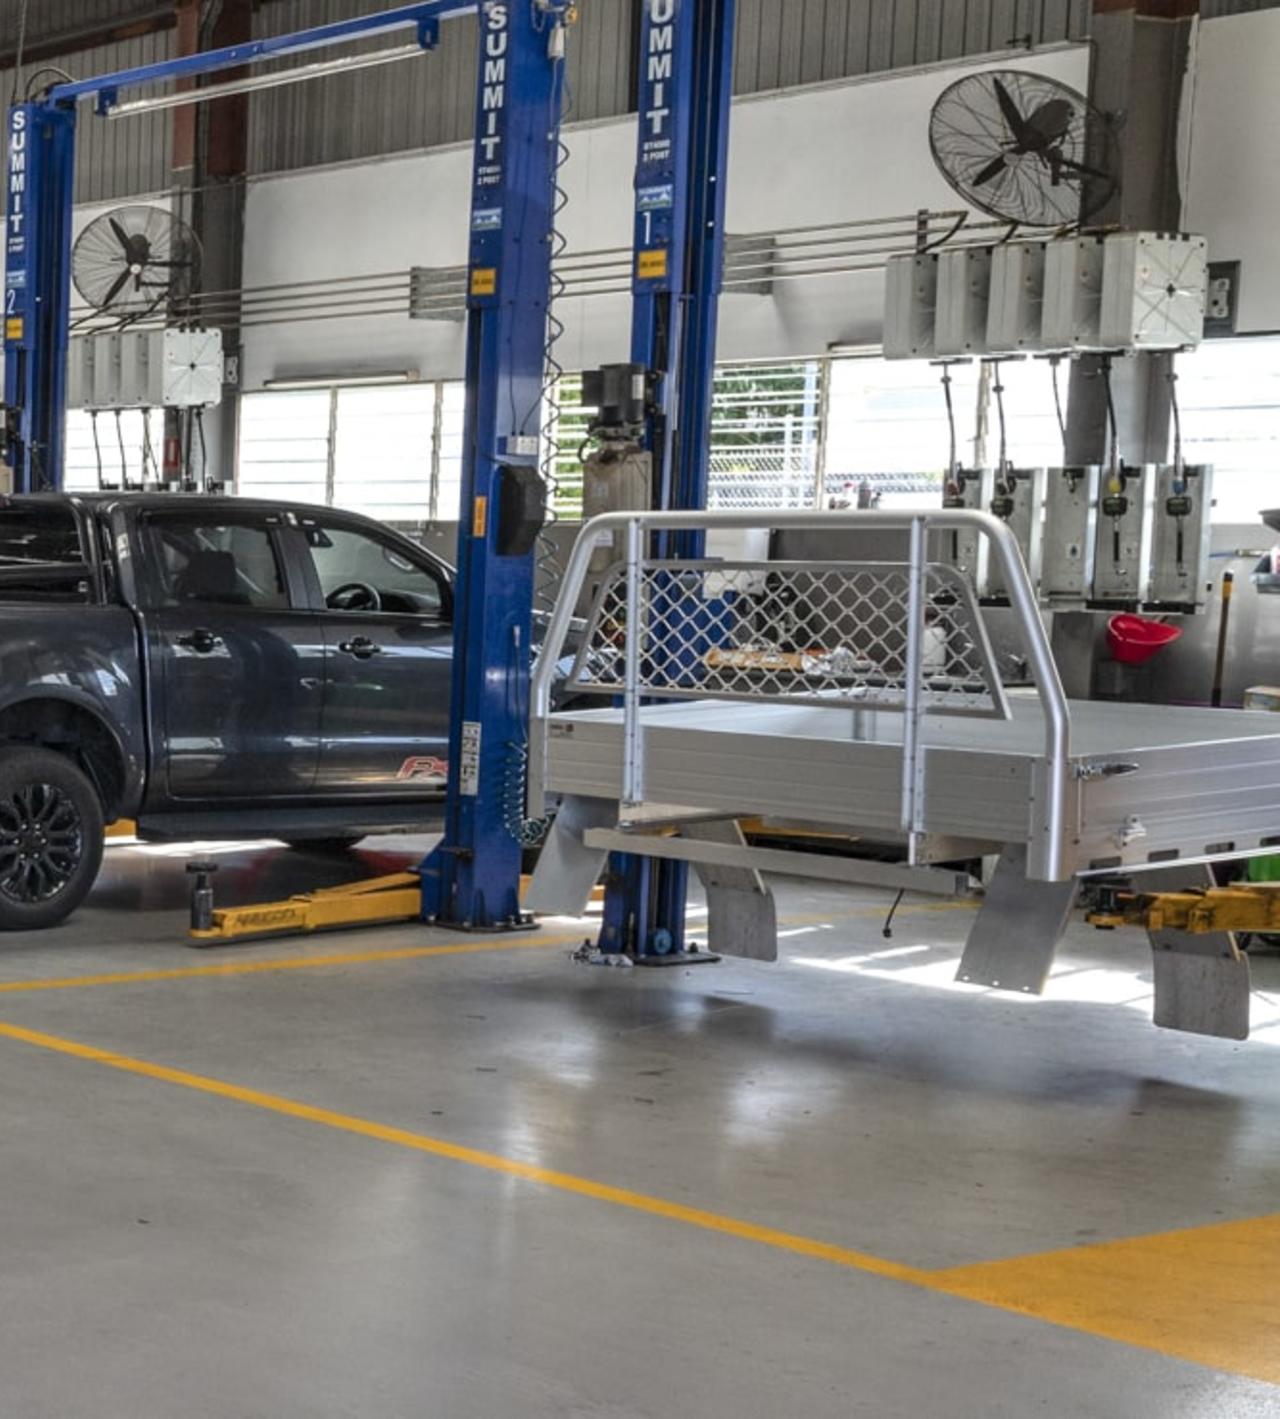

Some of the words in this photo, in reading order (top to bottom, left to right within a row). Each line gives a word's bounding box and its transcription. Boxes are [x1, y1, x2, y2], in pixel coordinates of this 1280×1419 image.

[481, 5, 507, 160] SUMMIT
[646, 0, 673, 134] UMMIT
[10, 111, 25, 234] SUMMIT
[643, 211, 651, 245] 1
[6, 289, 16, 314] 2
